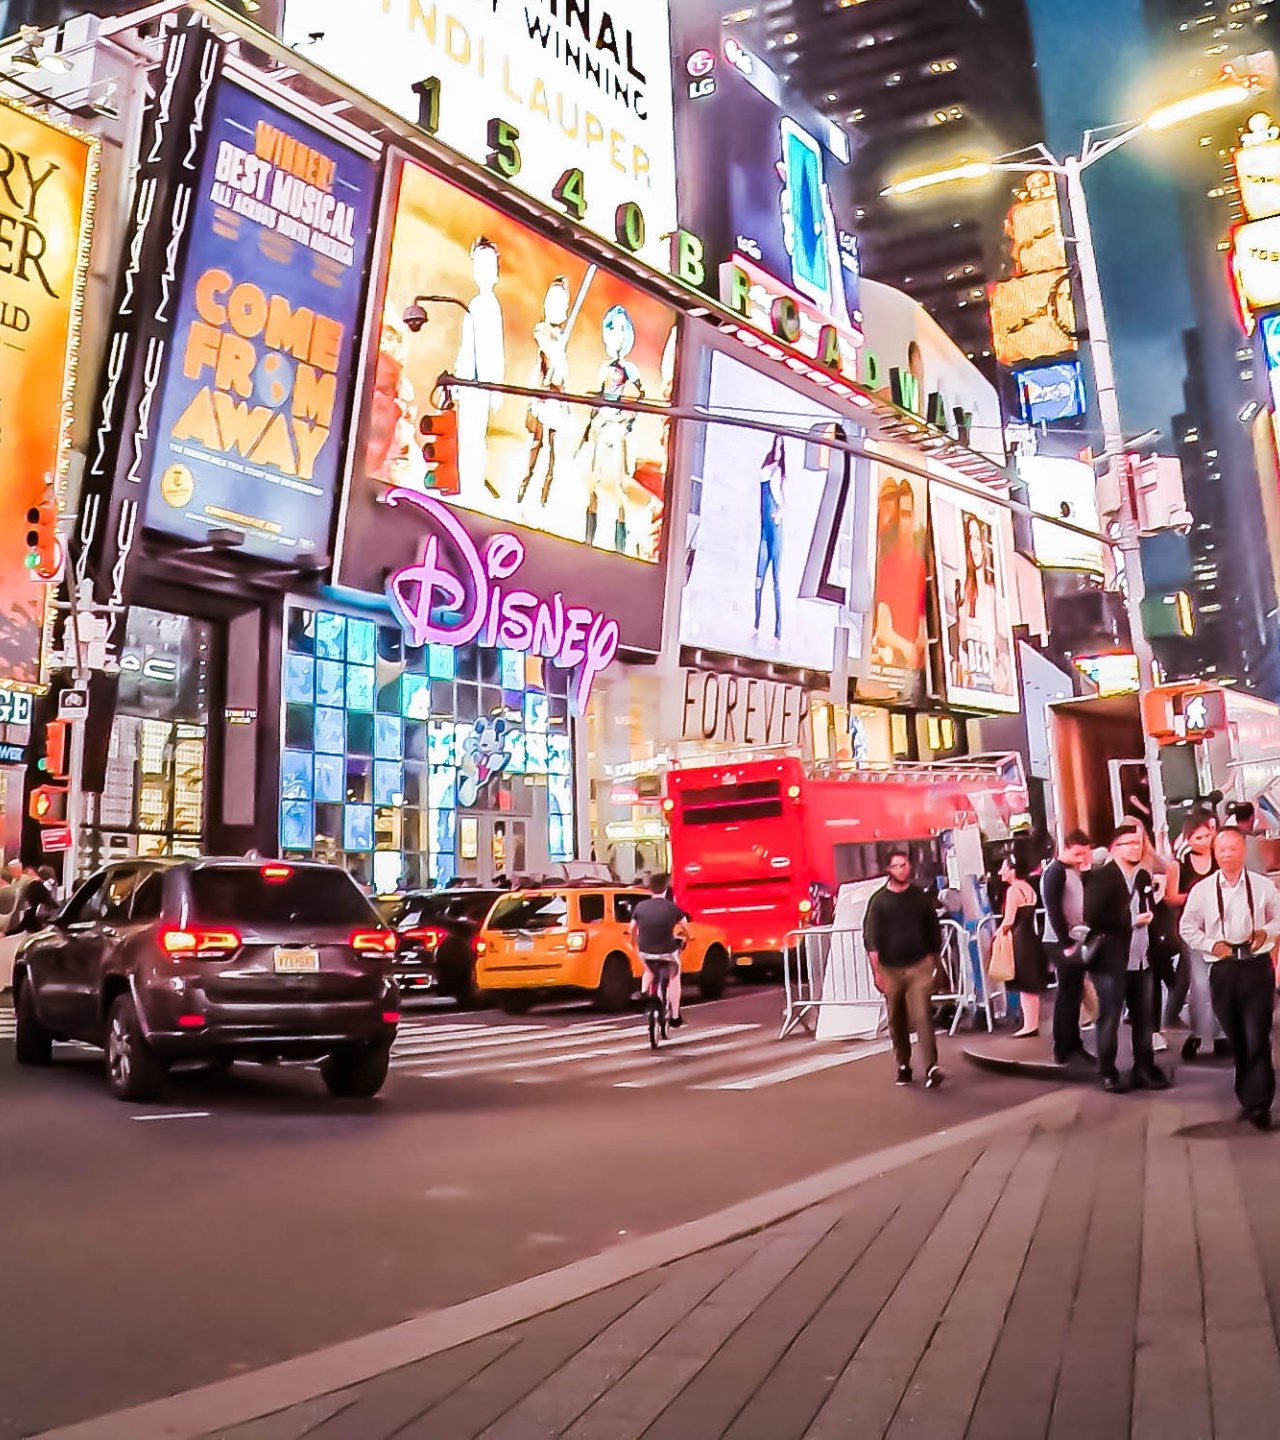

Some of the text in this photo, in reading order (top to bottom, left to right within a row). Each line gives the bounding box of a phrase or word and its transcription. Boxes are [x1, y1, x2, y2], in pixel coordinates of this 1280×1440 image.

[523, 6, 650, 122] WINNING
[410, 75, 648, 253] 1540
[502, 54, 653, 191] LAUPER
[214, 140, 357, 248] BEST MUSICAL
[182, 320, 338, 432] FROM
[193, 268, 345, 375] COME
[170, 385, 333, 480] AWAY
[681, 670, 811, 746] FOREVER
